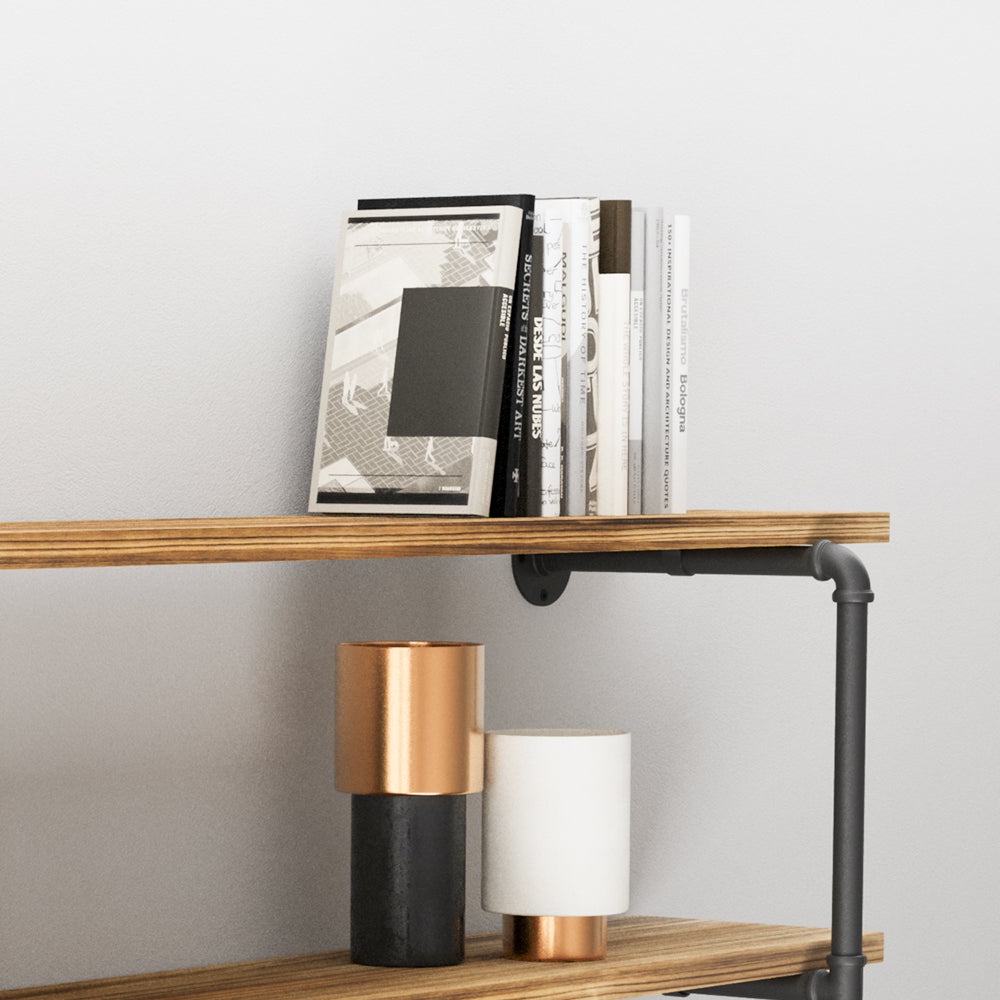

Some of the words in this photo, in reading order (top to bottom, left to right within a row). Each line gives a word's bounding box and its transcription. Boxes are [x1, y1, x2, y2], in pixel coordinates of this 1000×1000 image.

[521, 254, 532, 321] SECRETS
[533, 317, 543, 361] DESDE
[516, 335, 528, 407] DARKEST
[532, 365, 543, 392] LAS
[513, 410, 523, 441] ART
[531, 394, 542, 439] NUBES
[676, 374, 688, 433] Bologna
